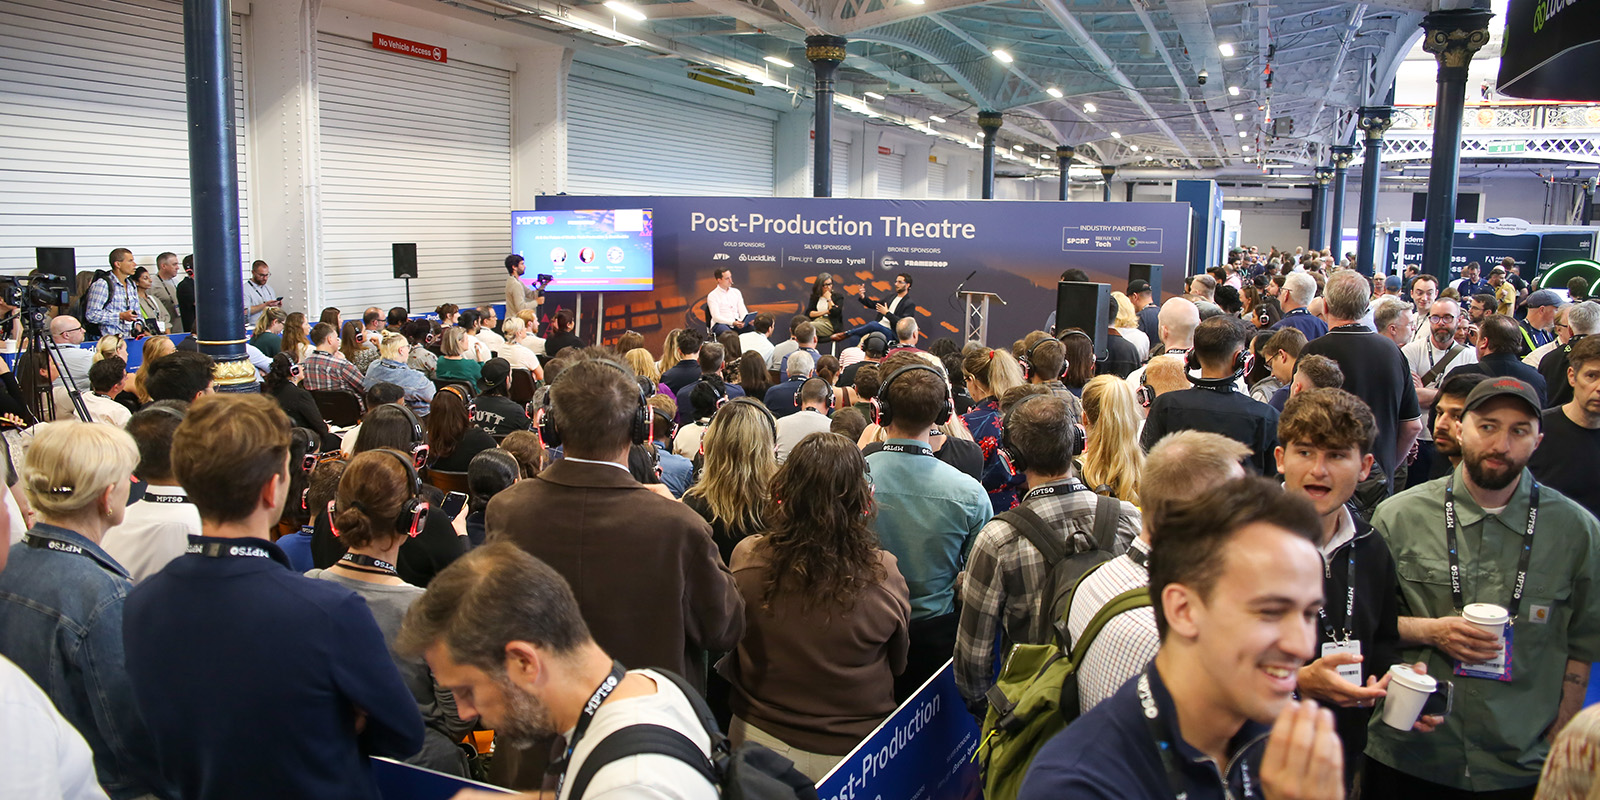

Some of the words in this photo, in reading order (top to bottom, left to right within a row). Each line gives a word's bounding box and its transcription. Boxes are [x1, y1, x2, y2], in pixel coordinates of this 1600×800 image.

[379, 38, 388, 47] No
[388, 40, 410, 52] Vehicle
[411, 45, 431, 56] Access
[691, 212, 873, 236] Post-Production
[880, 216, 976, 239] Theatre
[747, 254, 776, 262] LucidLink
[904, 260, 948, 268] FRAMEDROP
